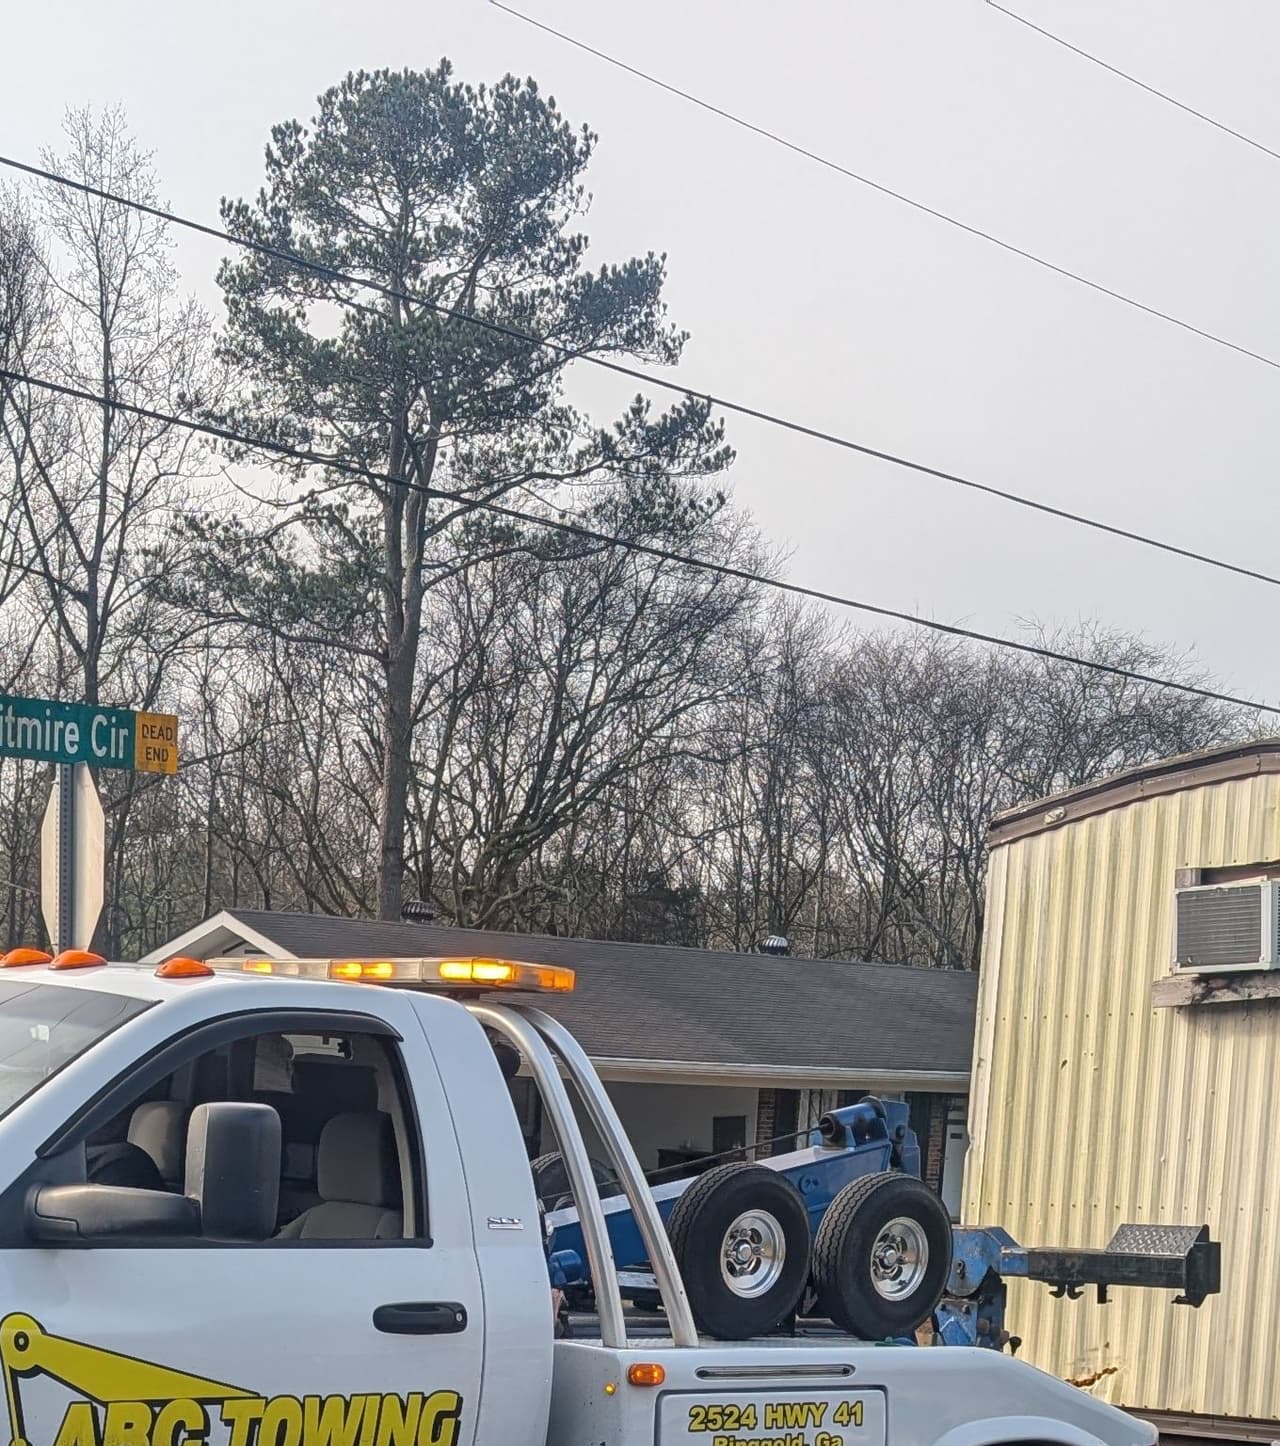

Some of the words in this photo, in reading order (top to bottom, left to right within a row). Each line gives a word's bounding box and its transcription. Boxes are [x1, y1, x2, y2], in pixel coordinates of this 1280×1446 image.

[90, 714, 129, 759] Cir
[141, 723, 174, 741] DEAD
[145, 746, 169, 762] END
[688, 1404, 757, 1432] 2524
[763, 1402, 829, 1429] HWY
[833, 1400, 864, 1427] 41
